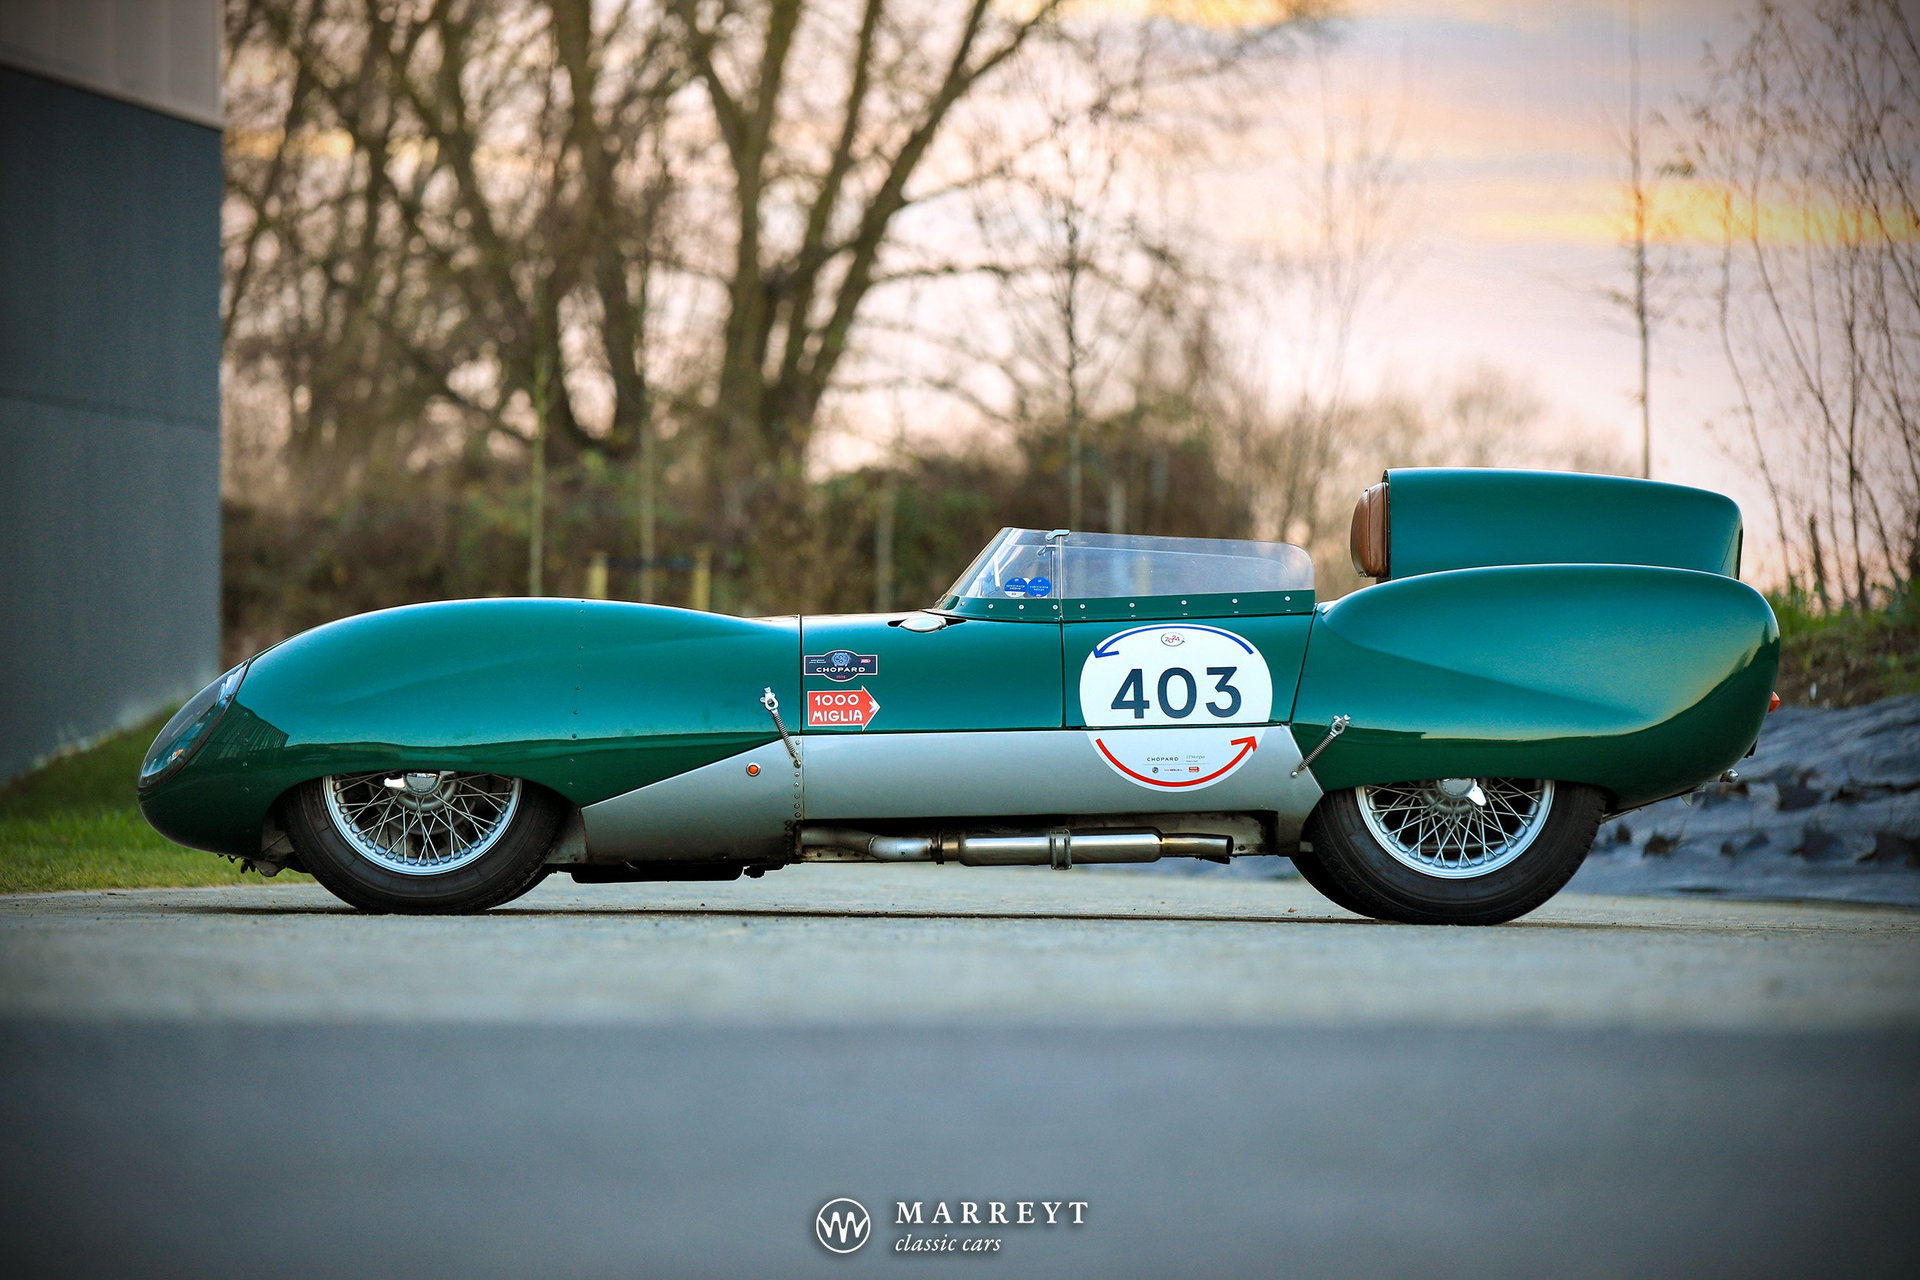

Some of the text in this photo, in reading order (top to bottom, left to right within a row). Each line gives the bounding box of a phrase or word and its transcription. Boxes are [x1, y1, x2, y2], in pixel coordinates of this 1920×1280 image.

[1111, 666, 1242, 719] 403
[814, 694, 859, 706] 1000
[812, 709, 863, 722] MIGLIA
